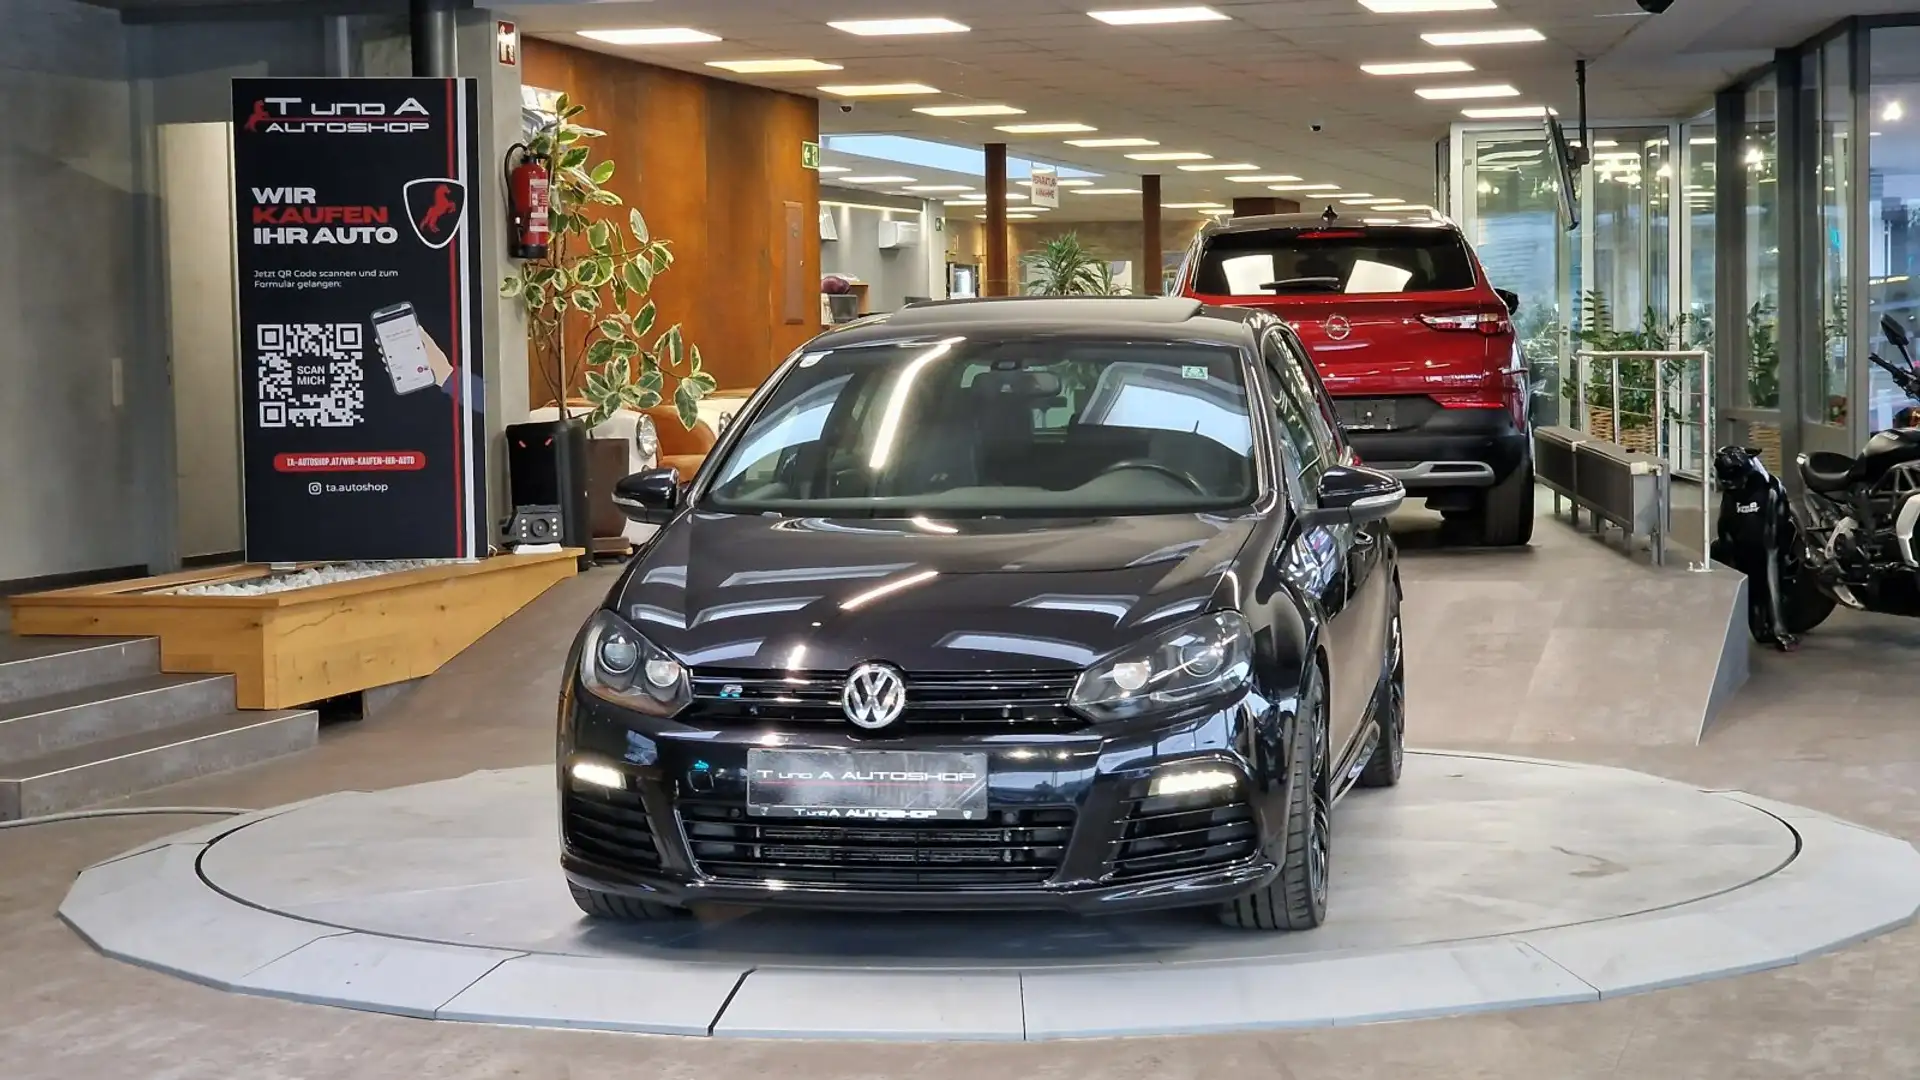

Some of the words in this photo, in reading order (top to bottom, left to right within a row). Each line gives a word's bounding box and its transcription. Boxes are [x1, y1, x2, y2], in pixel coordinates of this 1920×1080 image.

[264, 97, 302, 116] T
[393, 97, 430, 116] A
[264, 122, 430, 133] AUTOSHOP
[251, 187, 316, 204] WIR
[252, 206, 388, 224] KAUFEN
[253, 228, 309, 245] IHR
[311, 227, 399, 245] AUTO
[253, 269, 276, 278] Jetzt
[277, 269, 292, 279] QR
[293, 269, 317, 278] Code
[319, 270, 357, 278] scannen
[358, 269, 377, 278] und
[378, 270, 399, 278] zum
[254, 280, 295, 288] Formular
[296, 280, 342, 290] gelangen:
[297, 365, 325, 375] SCAN
[297, 375, 325, 385] MICH
[325, 482, 389, 493] ta.autoshop
[756, 769, 774, 779] T
[818, 771, 836, 780] A
[841, 771, 977, 781] AUTOSHOP
[793, 808, 806, 816] T
[828, 808, 841, 817] A
[845, 808, 938, 818] AUTOSHOP
